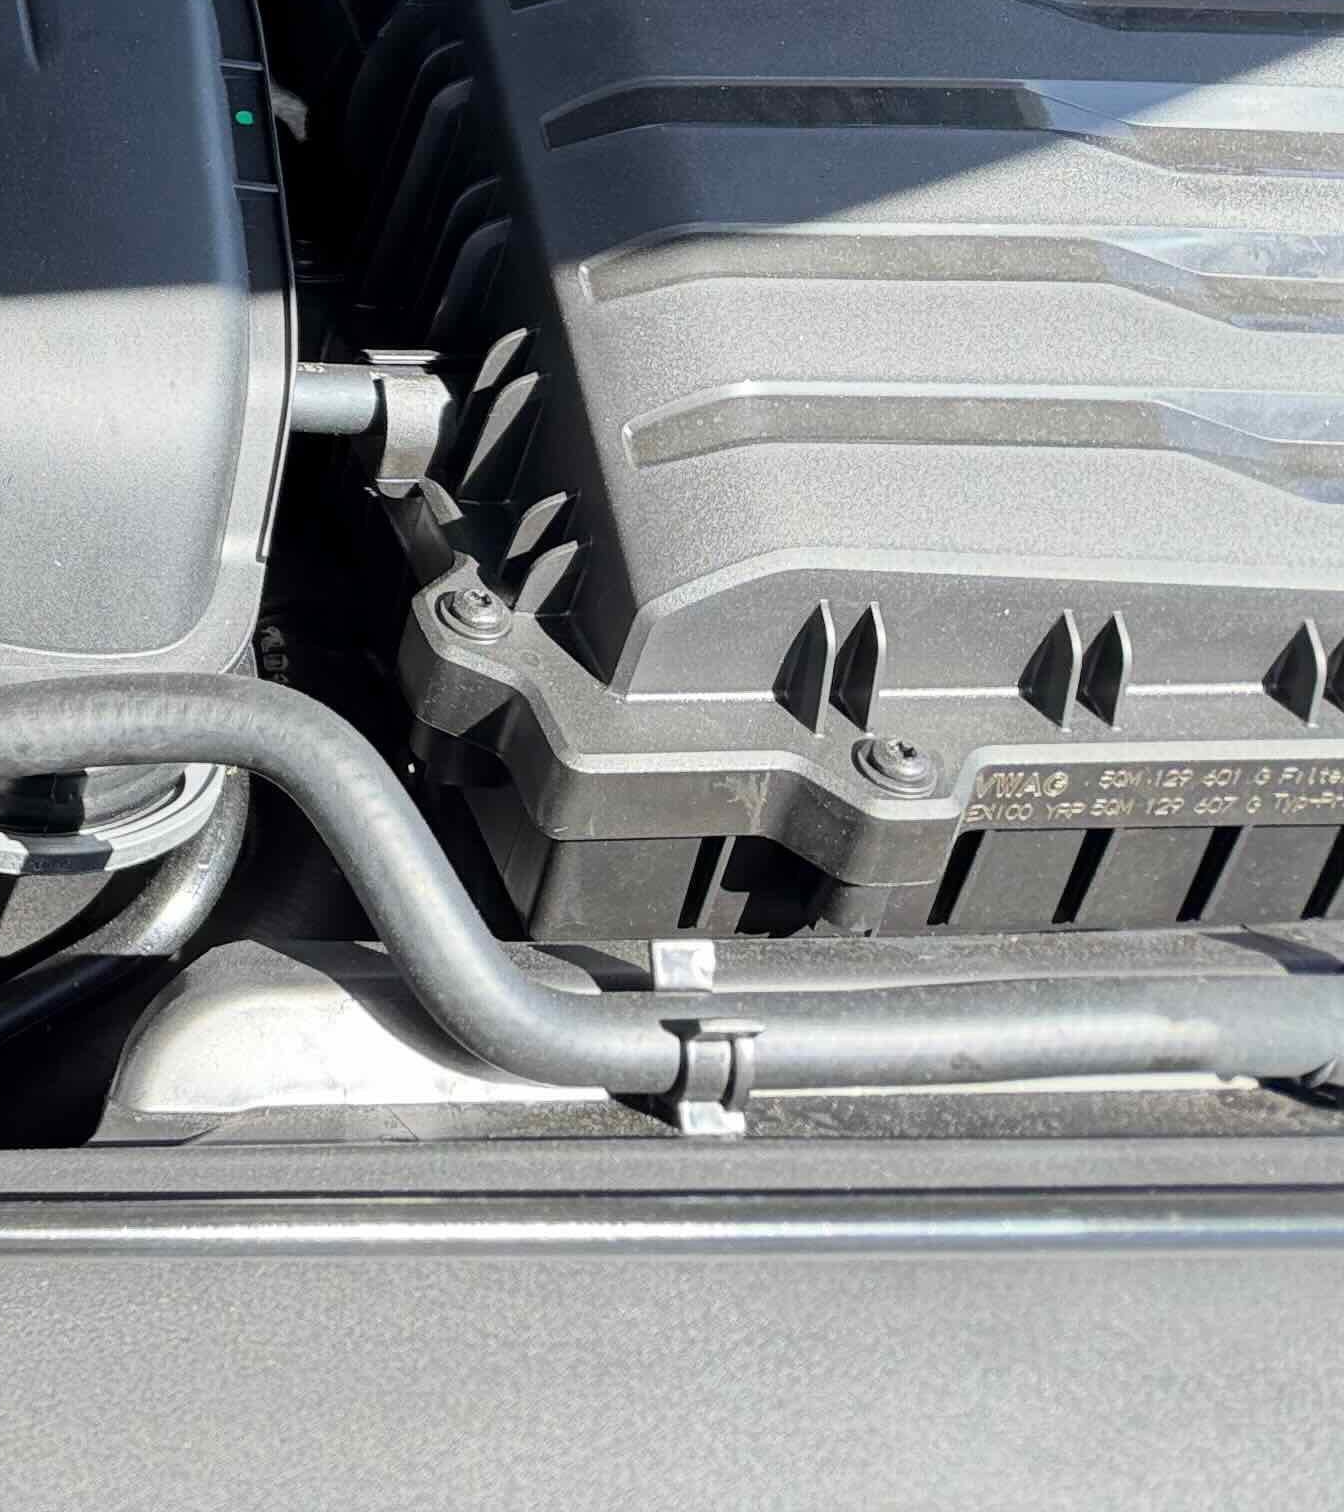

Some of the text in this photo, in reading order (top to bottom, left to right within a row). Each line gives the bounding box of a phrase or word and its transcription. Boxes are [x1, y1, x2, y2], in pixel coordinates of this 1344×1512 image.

[974, 770, 1070, 799] VWAG
[1154, 768, 1195, 788] 129
[1200, 767, 1243, 788] 601
[1279, 766, 1344, 786] Filte
[1144, 796, 1185, 816] 129
[1193, 795, 1240, 815] 607
